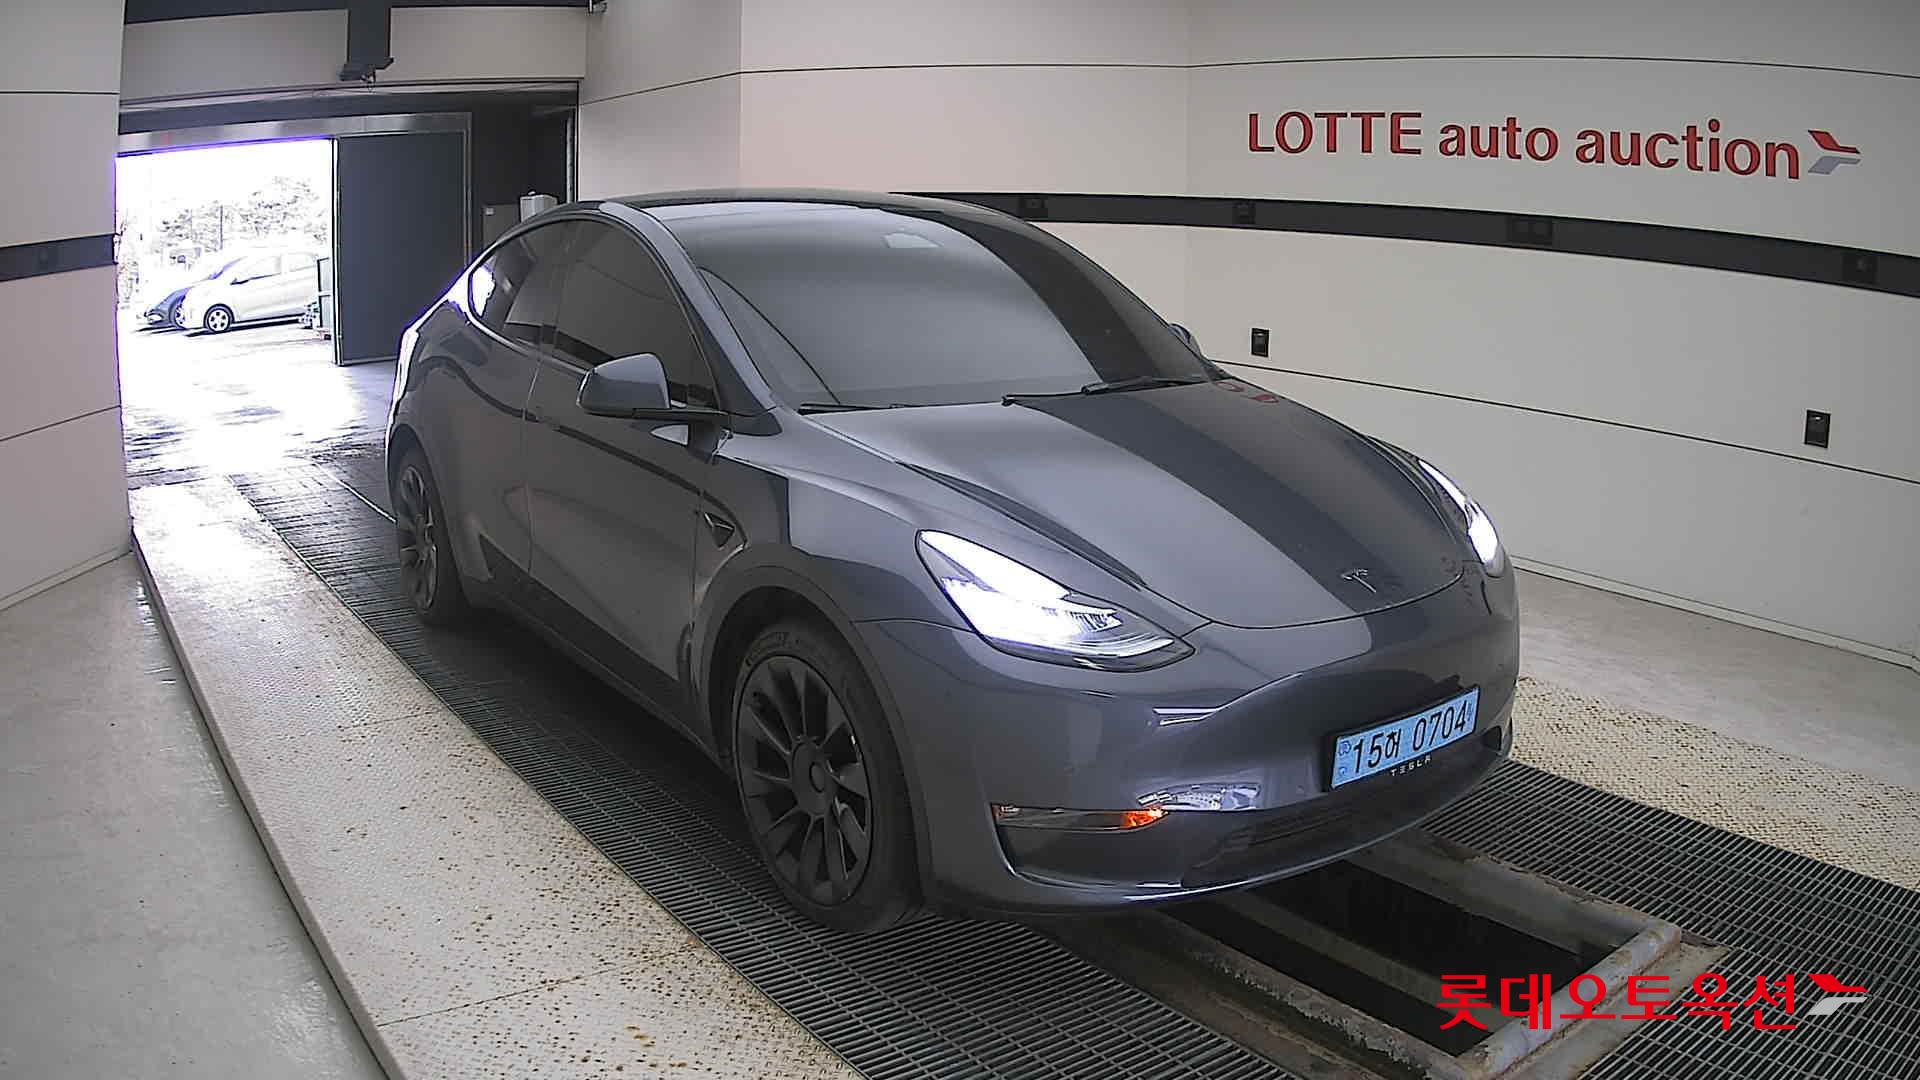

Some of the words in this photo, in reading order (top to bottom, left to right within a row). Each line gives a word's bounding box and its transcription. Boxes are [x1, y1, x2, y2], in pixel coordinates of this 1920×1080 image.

[1247, 111, 1423, 156] LOTTE
[1438, 116, 1560, 162] auto
[1574, 118, 1801, 180] auction
[1353, 728, 1402, 774] 15허
[1412, 699, 1468, 751] 0704
[1389, 754, 1432, 777] TESLA
